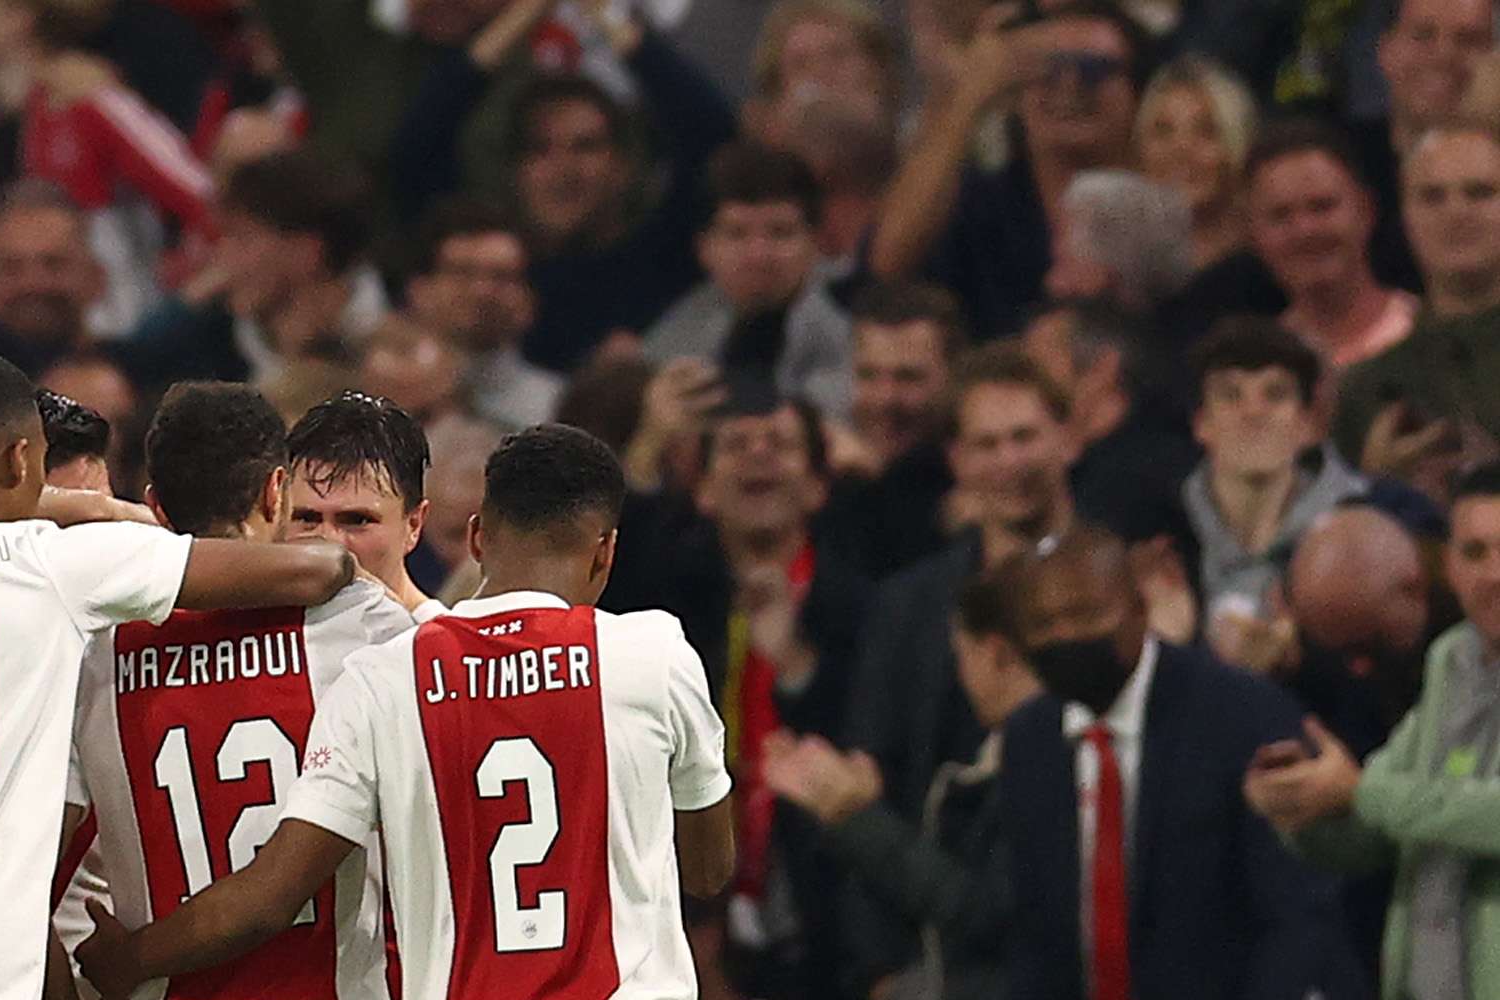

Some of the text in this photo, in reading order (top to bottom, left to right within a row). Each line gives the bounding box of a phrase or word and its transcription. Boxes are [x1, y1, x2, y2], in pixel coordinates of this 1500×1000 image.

[117, 630, 301, 694] MAZRAOUI
[154, 717, 317, 926] 12
[476, 736, 567, 953] 2
